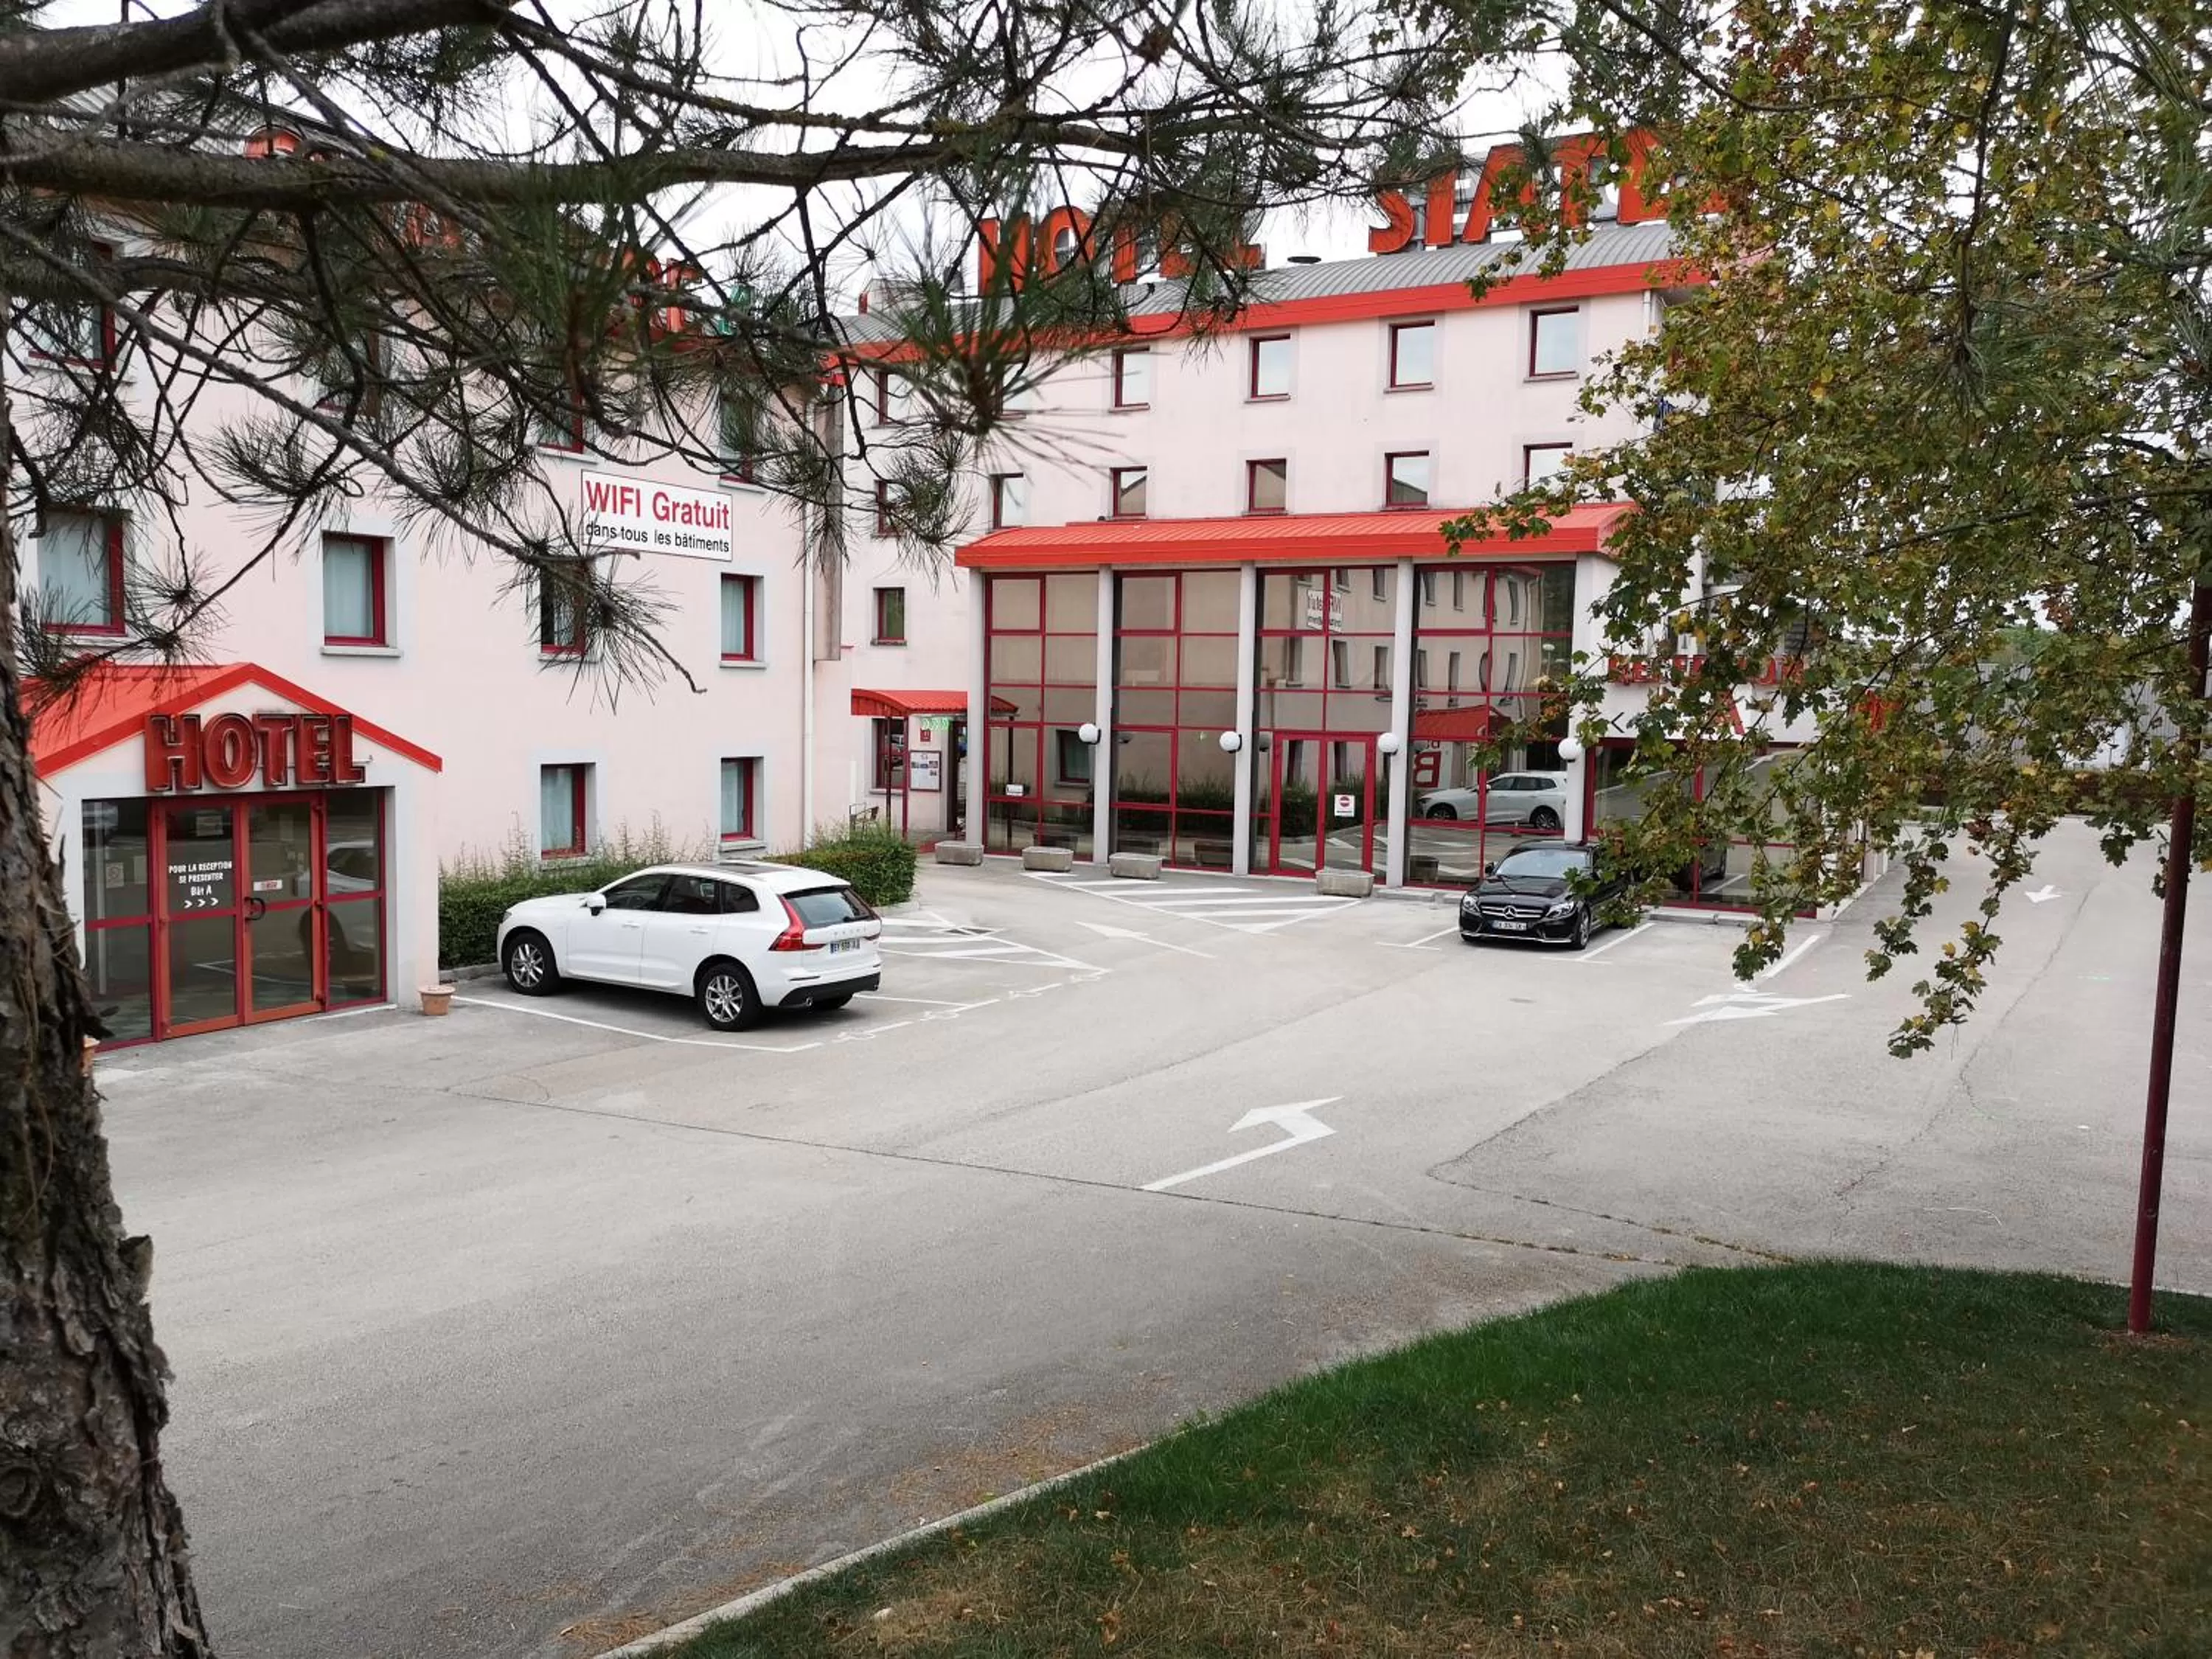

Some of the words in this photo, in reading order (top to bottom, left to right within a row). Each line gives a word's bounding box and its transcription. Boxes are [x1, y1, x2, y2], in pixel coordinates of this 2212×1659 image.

[585, 480, 641, 518] WIFI
[652, 491, 729, 530] Gratuit
[585, 520, 617, 539] dans
[621, 526, 648, 543] tous
[654, 529, 671, 545] les
[675, 531, 729, 552] bâtiments
[145, 712, 366, 792] HOTEL
[168, 865, 187, 874] POUR
[188, 863, 197, 872] LA
[198, 860, 232, 872] RECEPTION
[178, 874, 187, 884] SE
[188, 872, 223, 883] PRESENTER
[206, 884, 212, 895] A
